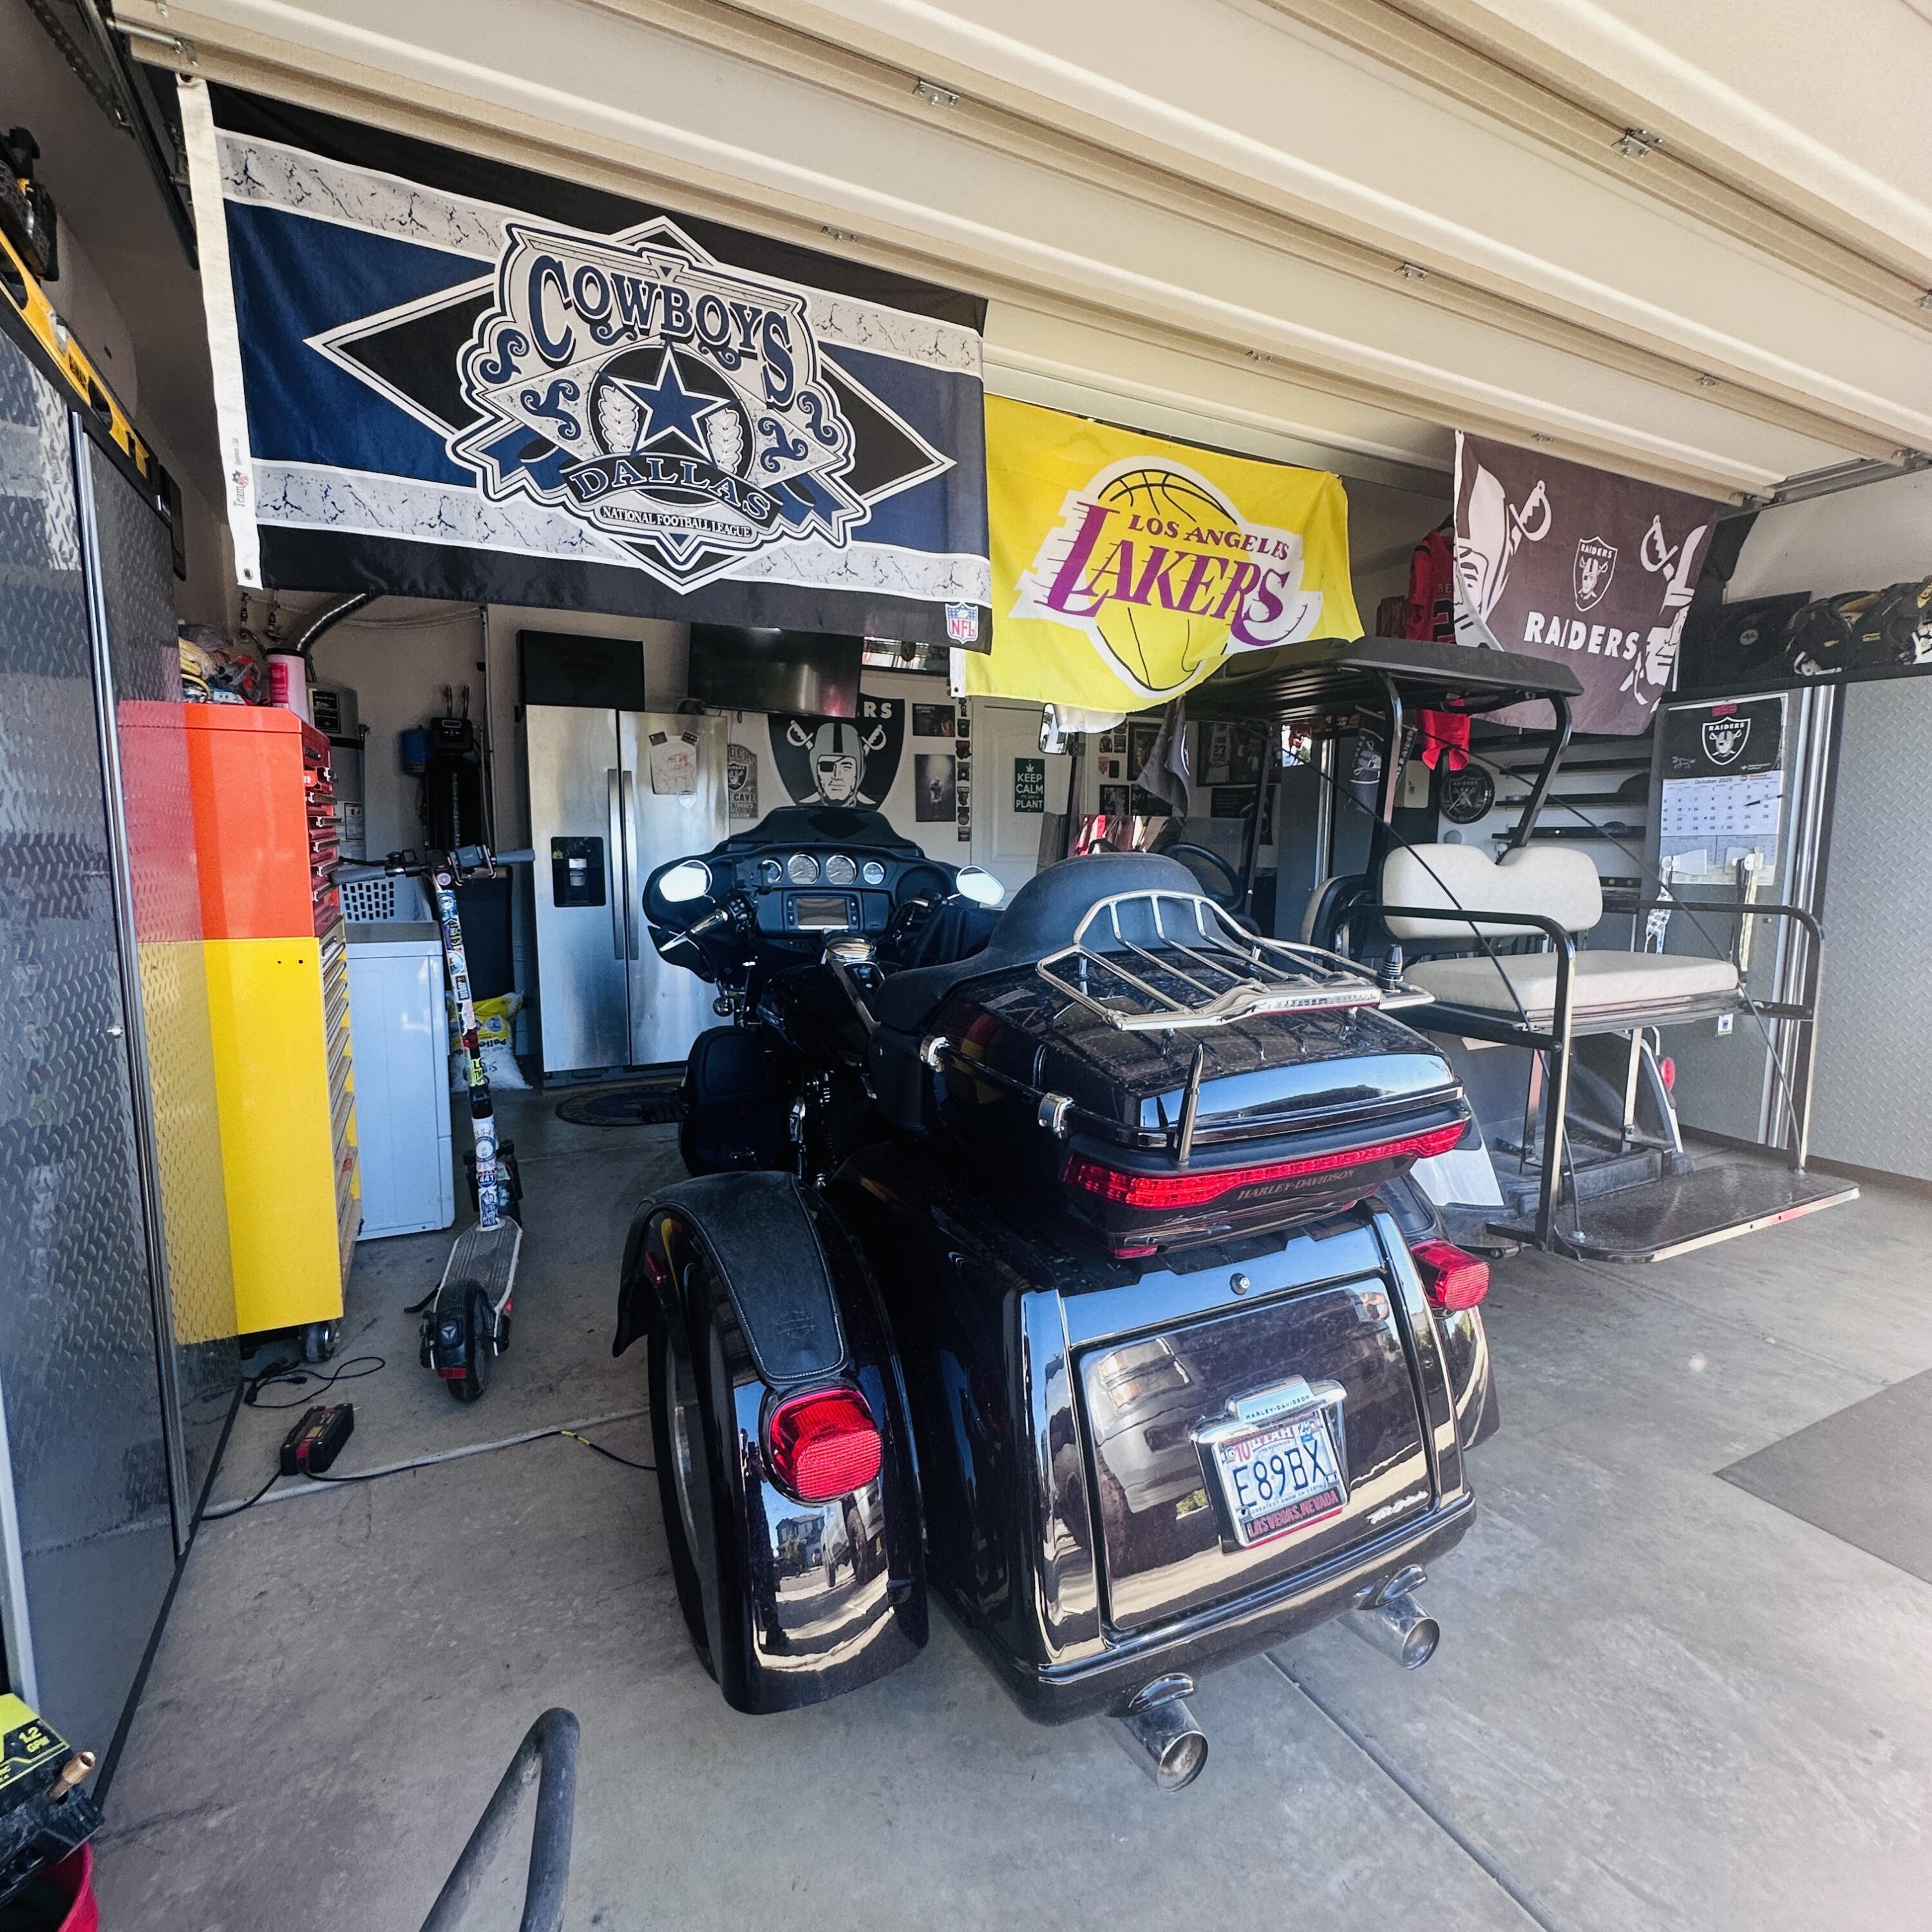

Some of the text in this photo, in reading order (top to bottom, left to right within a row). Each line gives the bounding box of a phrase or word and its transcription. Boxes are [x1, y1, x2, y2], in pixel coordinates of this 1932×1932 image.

[527, 255, 793, 410] COWBOYS
[571, 457, 770, 520] DALLAS
[602, 506, 752, 537] NATIONAL FOOTBALL LEAGUE
[1128, 514, 1289, 560] LOS ANGELES
[1580, 544, 1612, 558] RAIDERS
[1034, 501, 1307, 646] LAKERS
[1437, 583, 1452, 593] RE
[951, 619, 976, 640] NFL
[1524, 611, 1640, 660] RAIDERS
[1709, 722, 1745, 732] RAIDERS
[1016, 783, 1043, 794] CALM
[1018, 773, 1043, 782] KEEP
[734, 793, 755, 801] CAVE
[1016, 799, 1043, 808] PLANT
[1237, 1170, 1354, 1200] HARLEY-DAVIDSON
[1245, 1395, 1310, 1419] HARLEY-DAVIDSON
[1251, 1500, 1280, 1514] GREATEST
[1281, 1494, 1296, 1504] SHOW
[1307, 1484, 1323, 1493] EARTH
[1247, 1519, 1269, 1537] LAS
[1300, 1490, 1339, 1516] NEVADA
